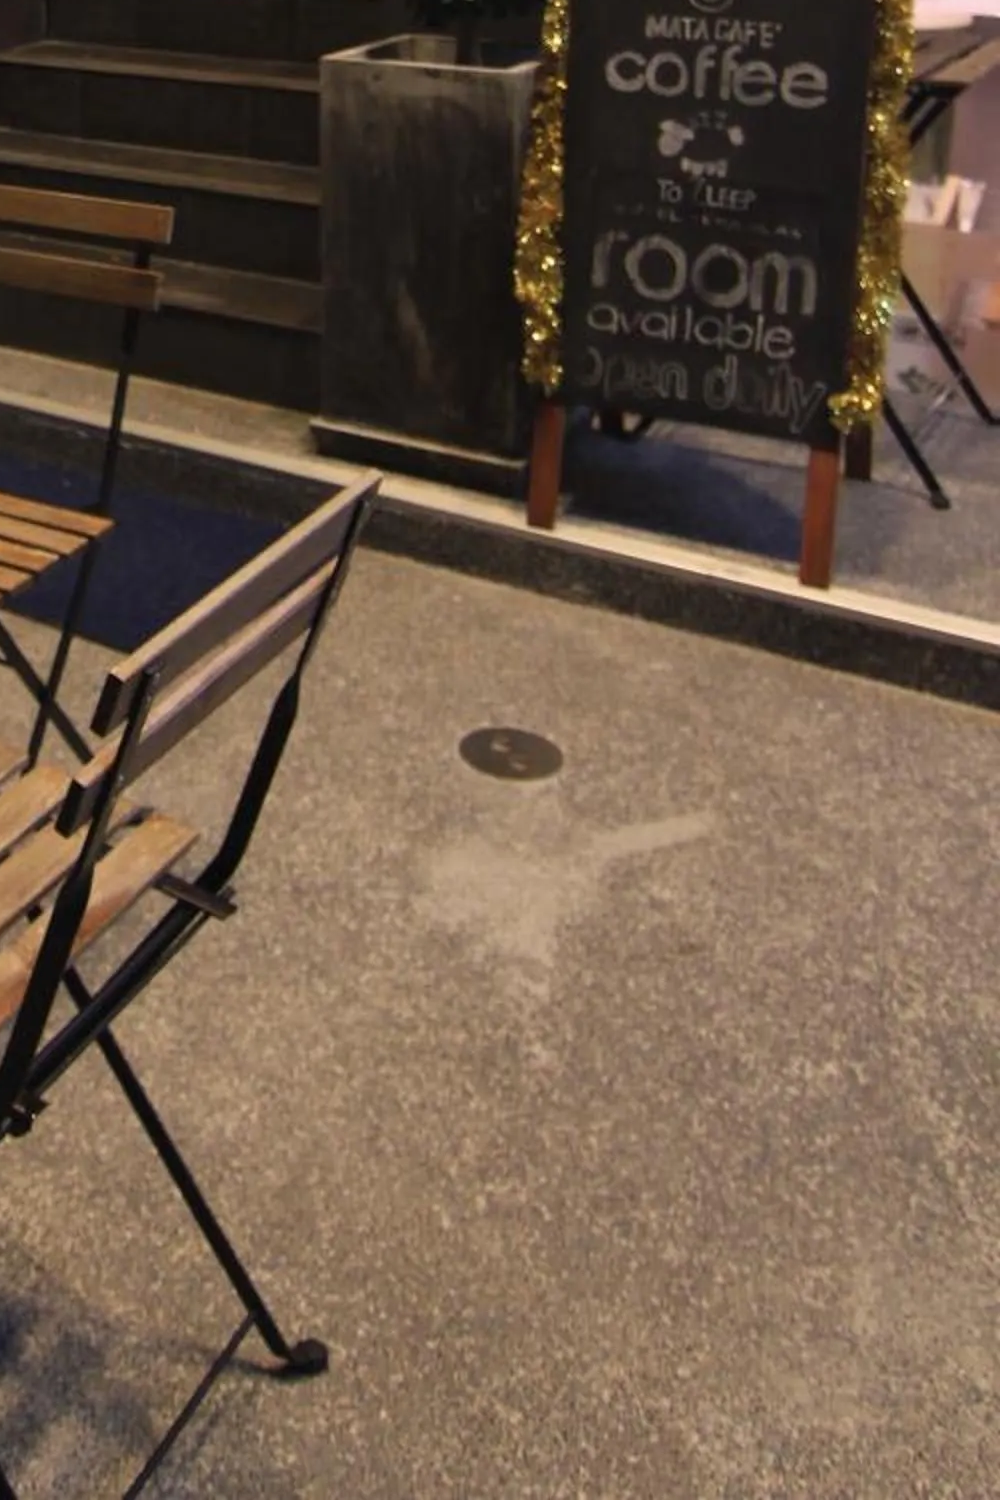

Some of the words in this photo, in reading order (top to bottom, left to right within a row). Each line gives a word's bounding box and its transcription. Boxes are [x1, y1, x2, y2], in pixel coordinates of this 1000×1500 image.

[645, 15, 709, 41] MATA
[606, 45, 829, 108] coffee
[591, 229, 817, 316] room
[586, 303, 796, 359] available
